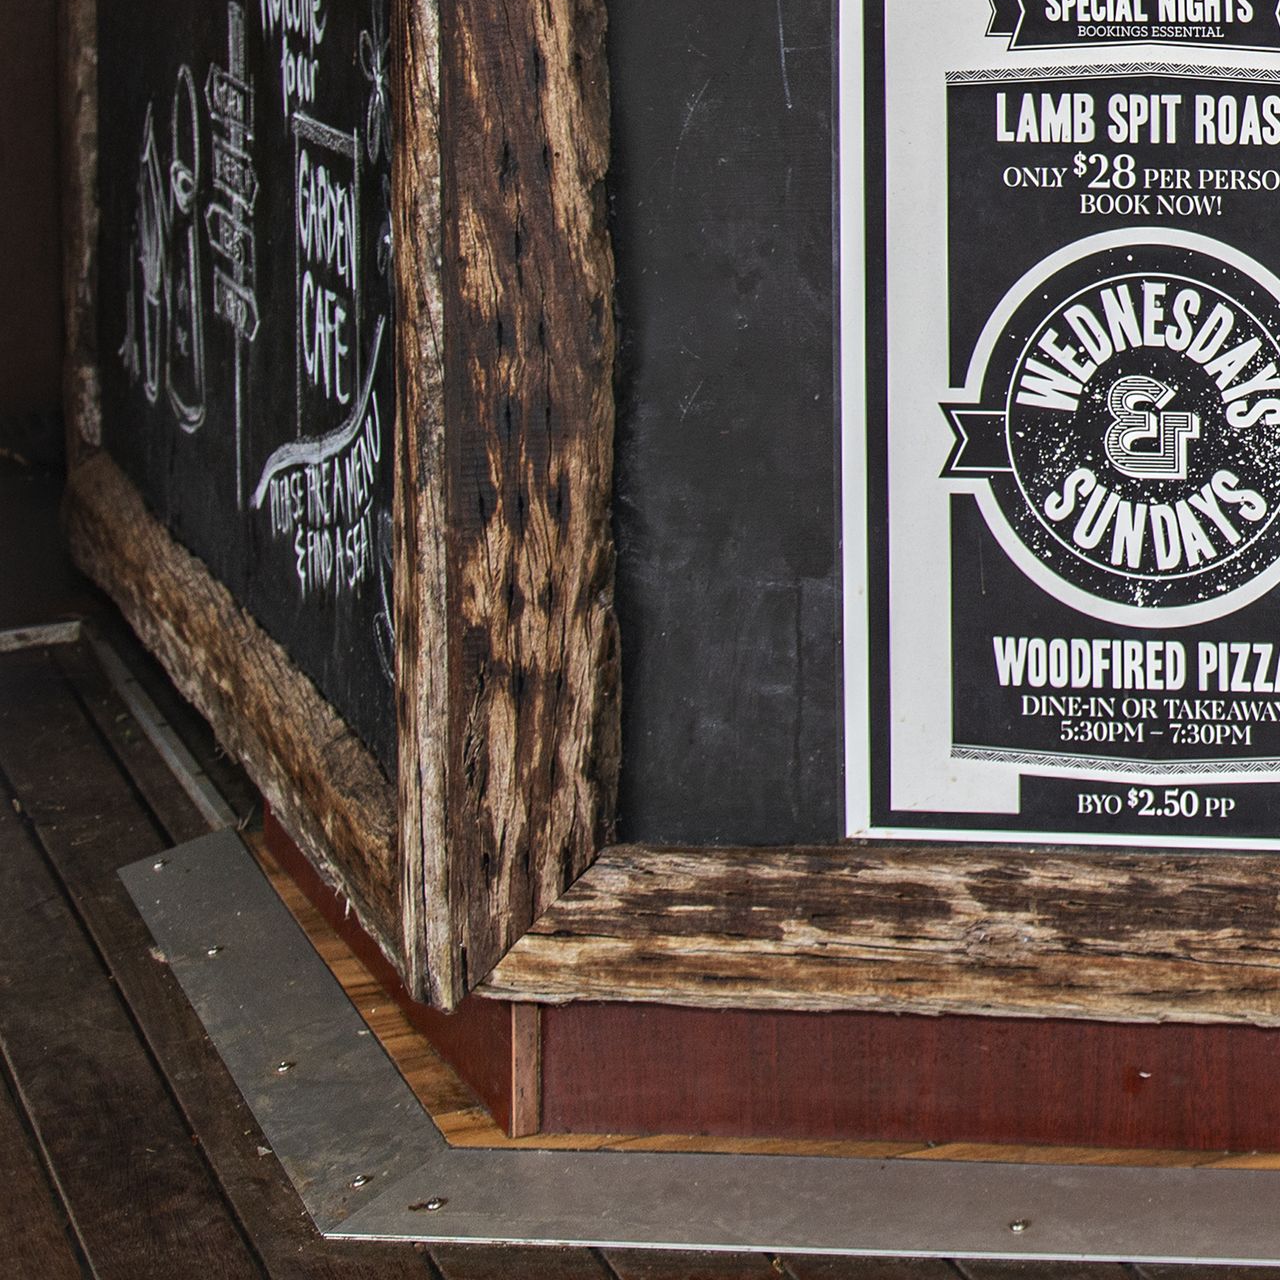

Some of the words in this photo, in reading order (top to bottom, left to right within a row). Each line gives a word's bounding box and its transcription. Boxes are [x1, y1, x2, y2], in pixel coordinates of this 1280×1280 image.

[1078, 25, 1148, 39] BOOKINGS
[1152, 25, 1224, 39] ESSENTIAL
[996, 92, 1095, 144] LAMB
[1108, 94, 1182, 145] SPIT
[1003, 167, 1068, 190] ONLY
[1073, 152, 1136, 190] $28
[1144, 169, 1192, 190] PER
[299, 148, 355, 292] GARDEN
[1079, 194, 1150, 216] BOOK
[1156, 195, 1222, 216] NOW!
[302, 279, 350, 406] CAFE
[1107, 375, 1200, 480] &
[270, 471, 304, 538] PLEASE
[304, 462, 331, 528] TAKE
[345, 391, 381, 525] MENU
[307, 528, 333, 592] FIND
[346, 496, 375, 590] SEAT
[1044, 467, 1268, 572] SUNDAYS
[994, 636, 1187, 692] WOODFIRED
[1021, 694, 1115, 719] DINE-IN
[1122, 696, 1158, 719] OR
[1060, 721, 1144, 743] 5:30PM
[1170, 723, 1252, 746] 7:30PM
[1078, 793, 1122, 816] BYO
[1127, 787, 1199, 818] $2.50
[1204, 795, 1235, 818] PP
